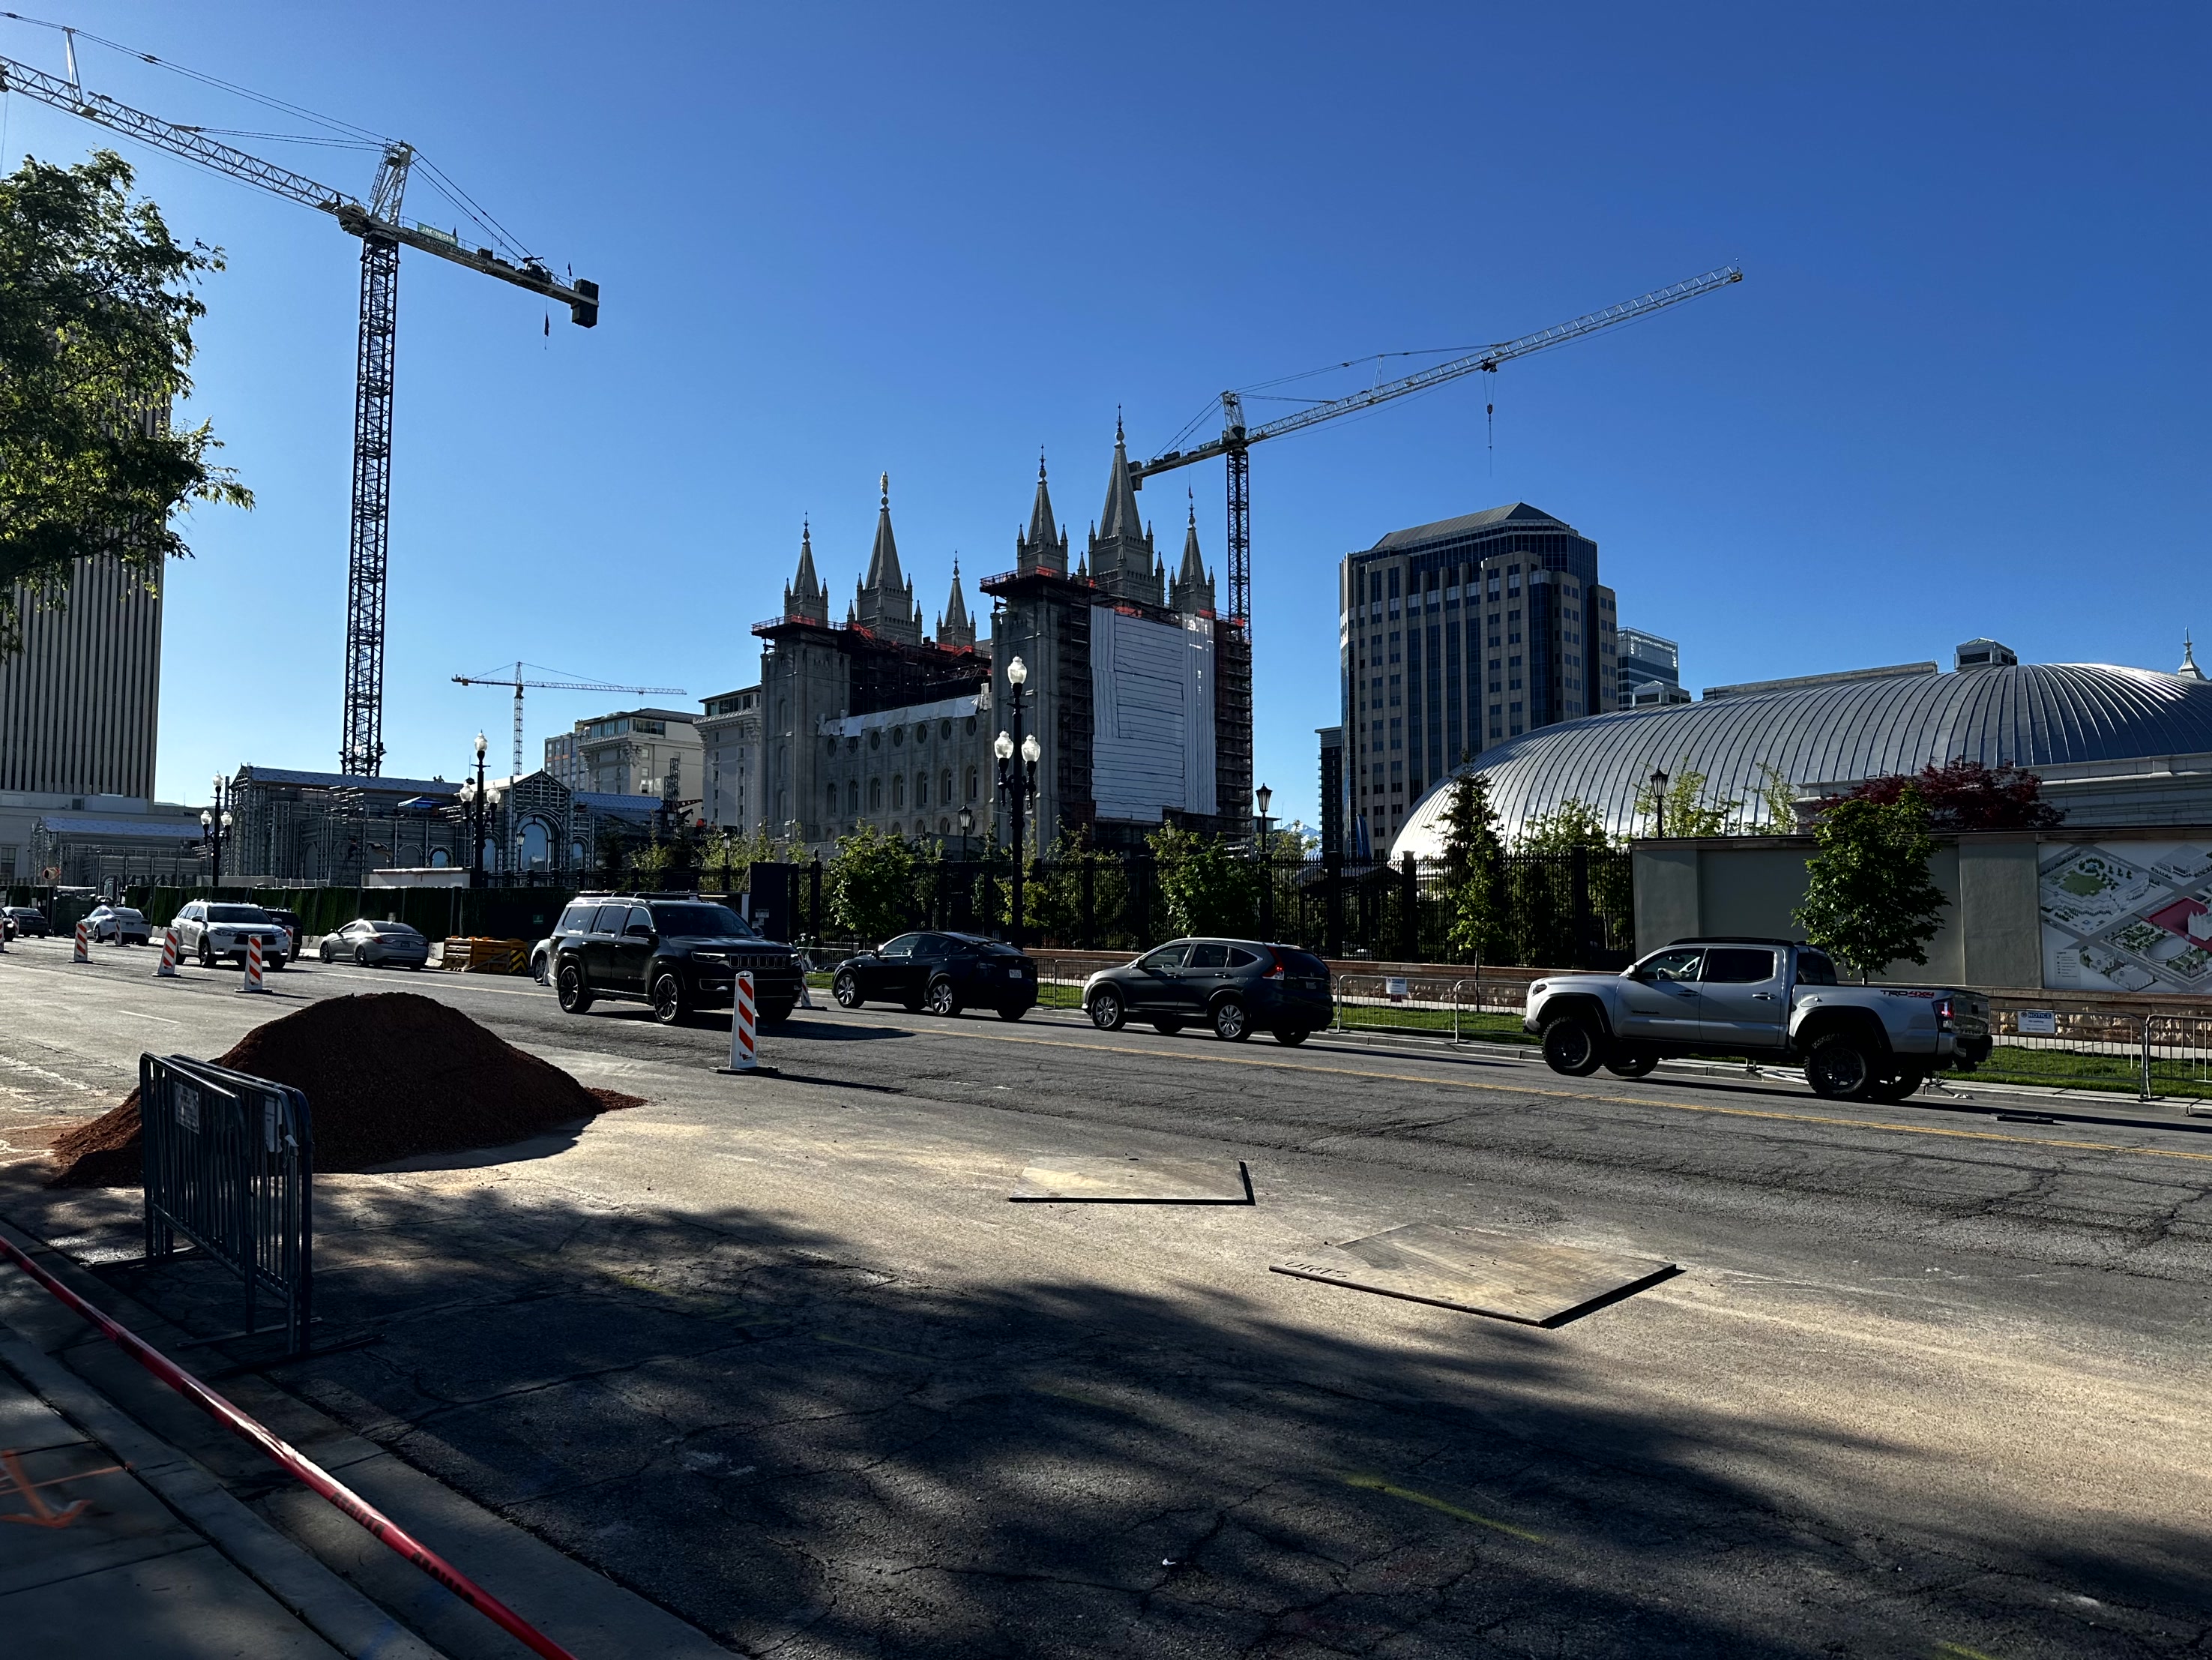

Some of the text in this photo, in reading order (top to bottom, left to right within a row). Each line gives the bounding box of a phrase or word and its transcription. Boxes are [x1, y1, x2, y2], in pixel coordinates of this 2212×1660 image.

[408, 231, 429, 242] BIGGE
[430, 238, 451, 251] TOWER
[421, 226, 456, 244] JACOBSEN
